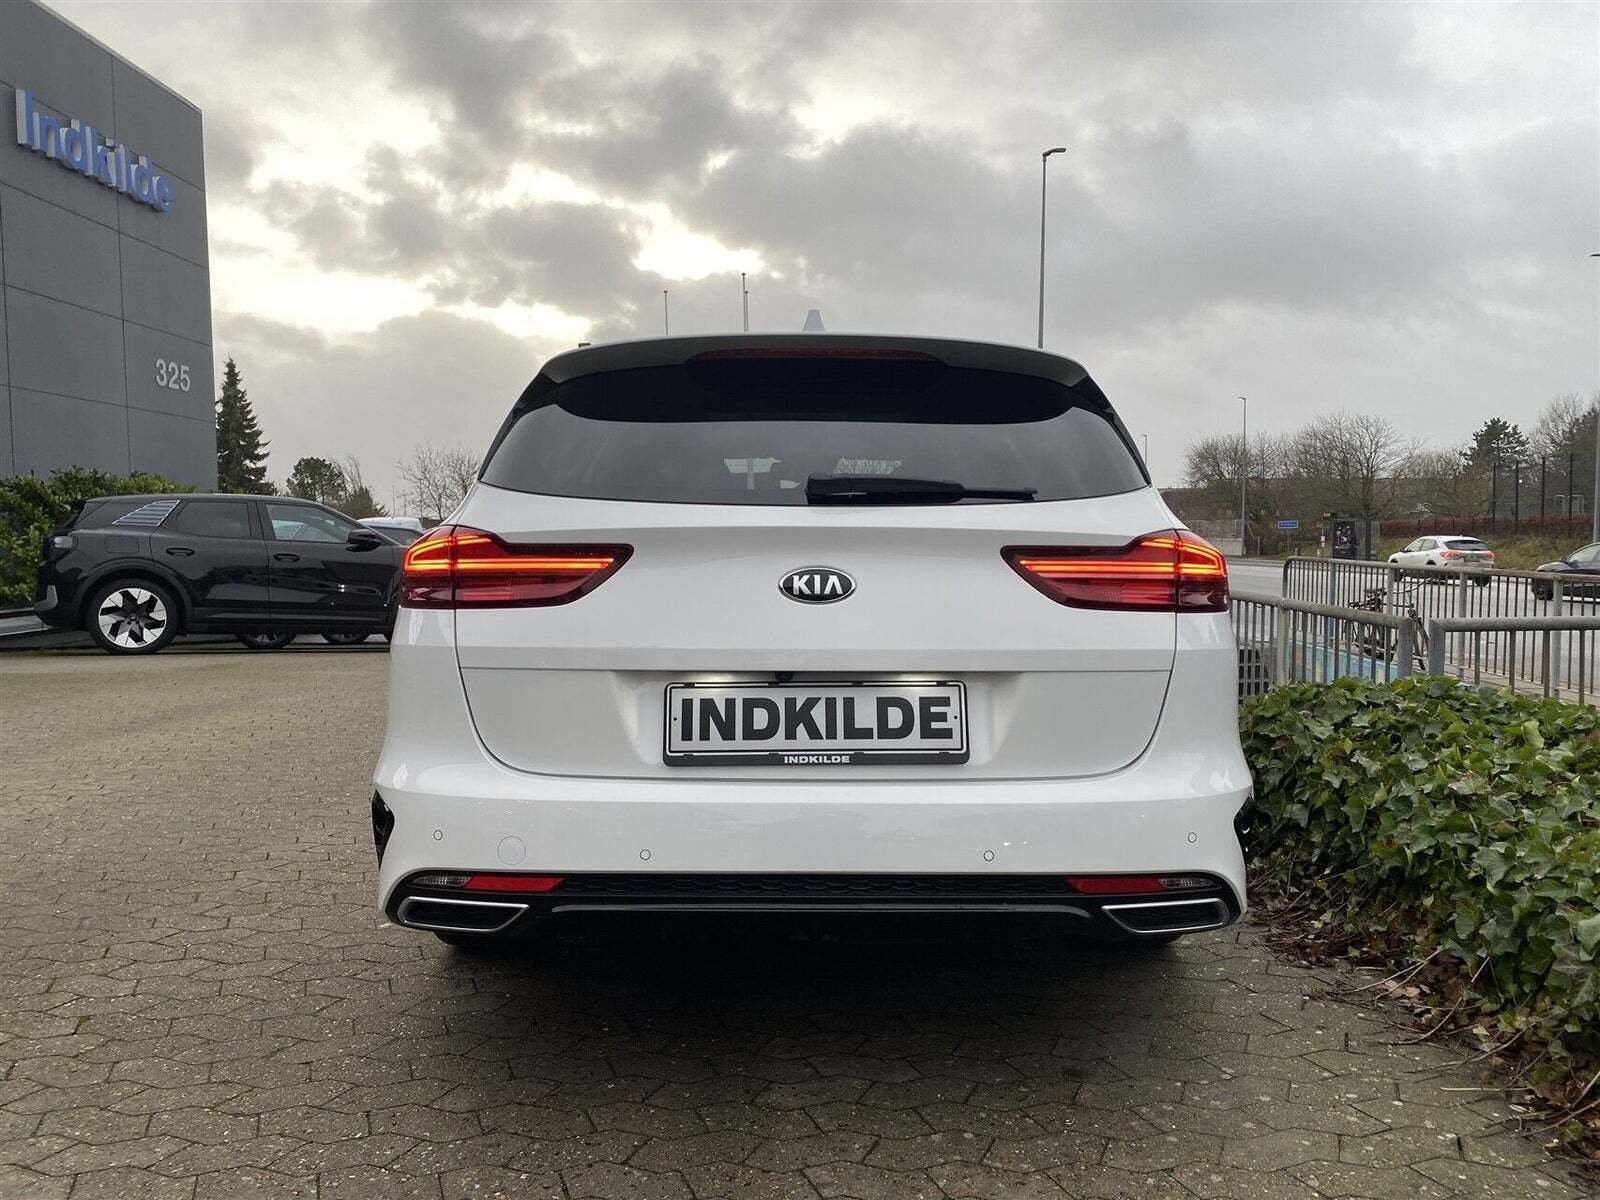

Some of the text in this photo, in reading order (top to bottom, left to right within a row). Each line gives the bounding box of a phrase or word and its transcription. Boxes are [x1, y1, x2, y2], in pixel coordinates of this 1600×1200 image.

[15, 88, 174, 213] Indkilde
[154, 358, 191, 392] 325
[791, 574, 844, 595] KIA
[681, 696, 953, 742] INDKILDE
[784, 755, 851, 764] INDKILDE
